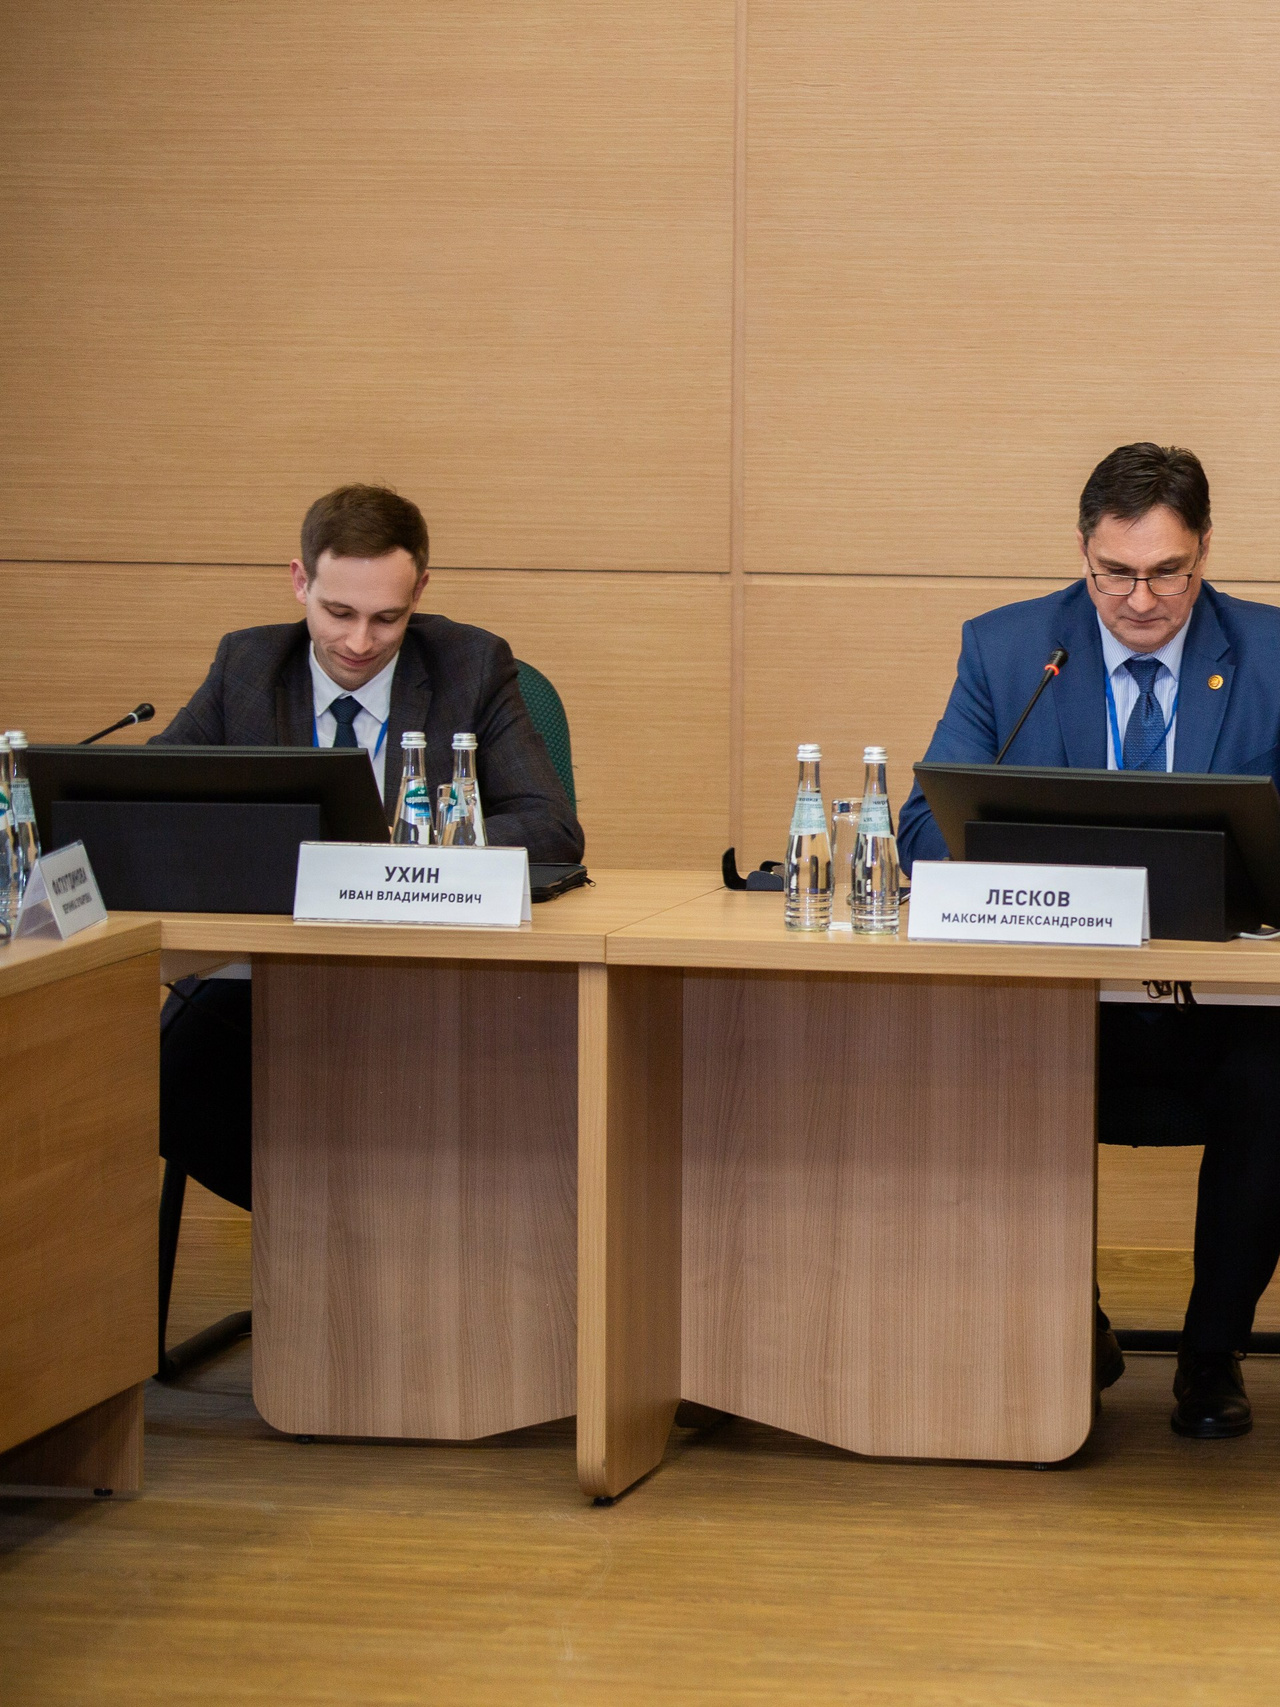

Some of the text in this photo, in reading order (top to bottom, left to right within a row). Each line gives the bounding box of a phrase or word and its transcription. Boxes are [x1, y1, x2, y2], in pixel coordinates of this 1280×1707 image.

[384, 866, 440, 884] УХИН
[339, 889, 482, 904] ИВАН ВЛАДИМИРОВИЧ
[986, 889, 1070, 907] ЛЕСКОВ
[941, 912, 1113, 928] МАКСИМ АЛЕКСАНДРОВИЧ
